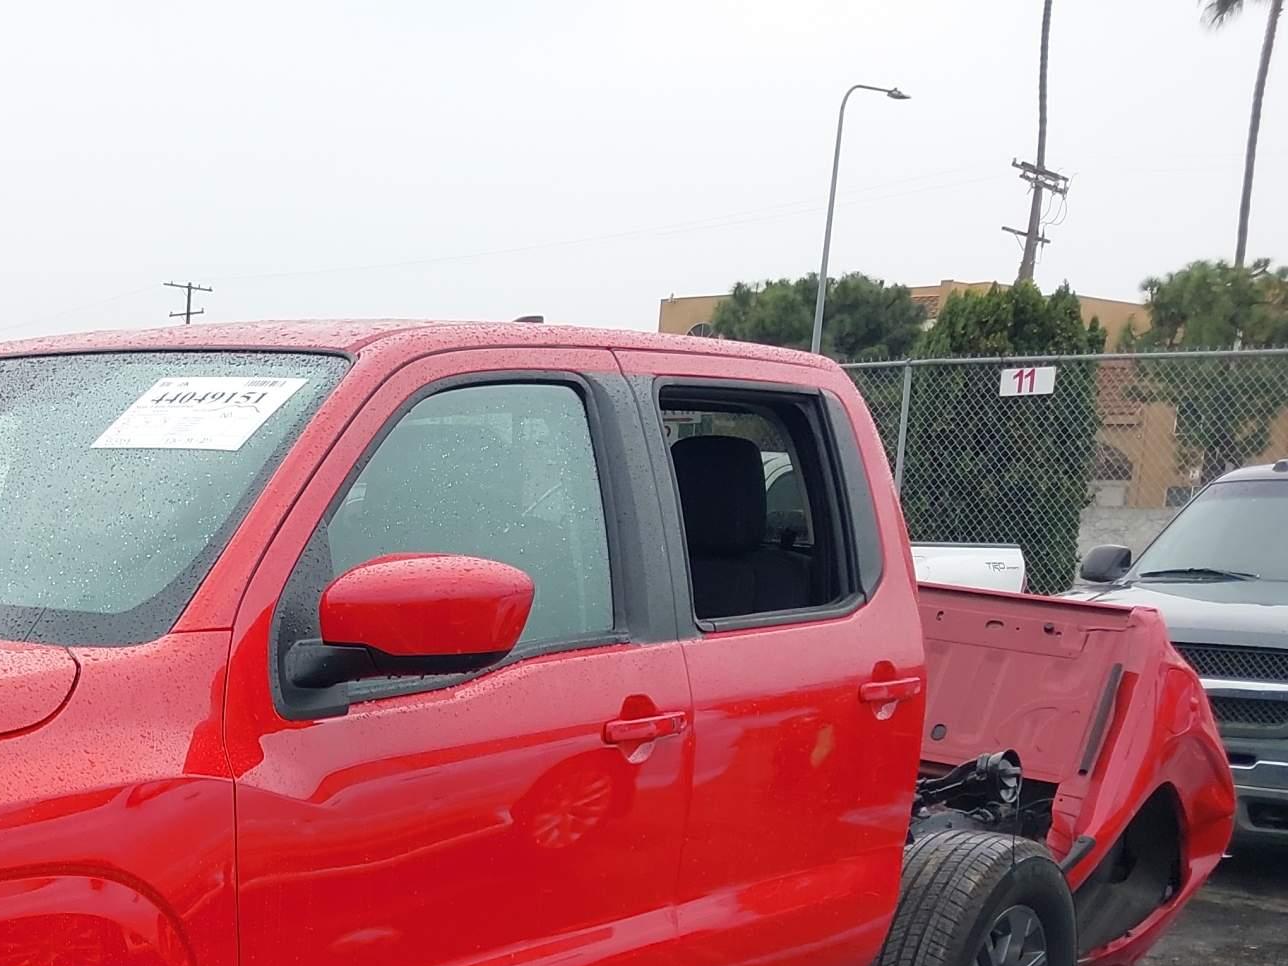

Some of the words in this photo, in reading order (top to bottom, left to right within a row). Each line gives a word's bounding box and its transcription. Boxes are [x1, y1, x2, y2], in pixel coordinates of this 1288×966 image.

[1013, 367, 1036, 393] 11
[150, 391, 268, 405] 44049151
[985, 561, 1005, 572] TRD
